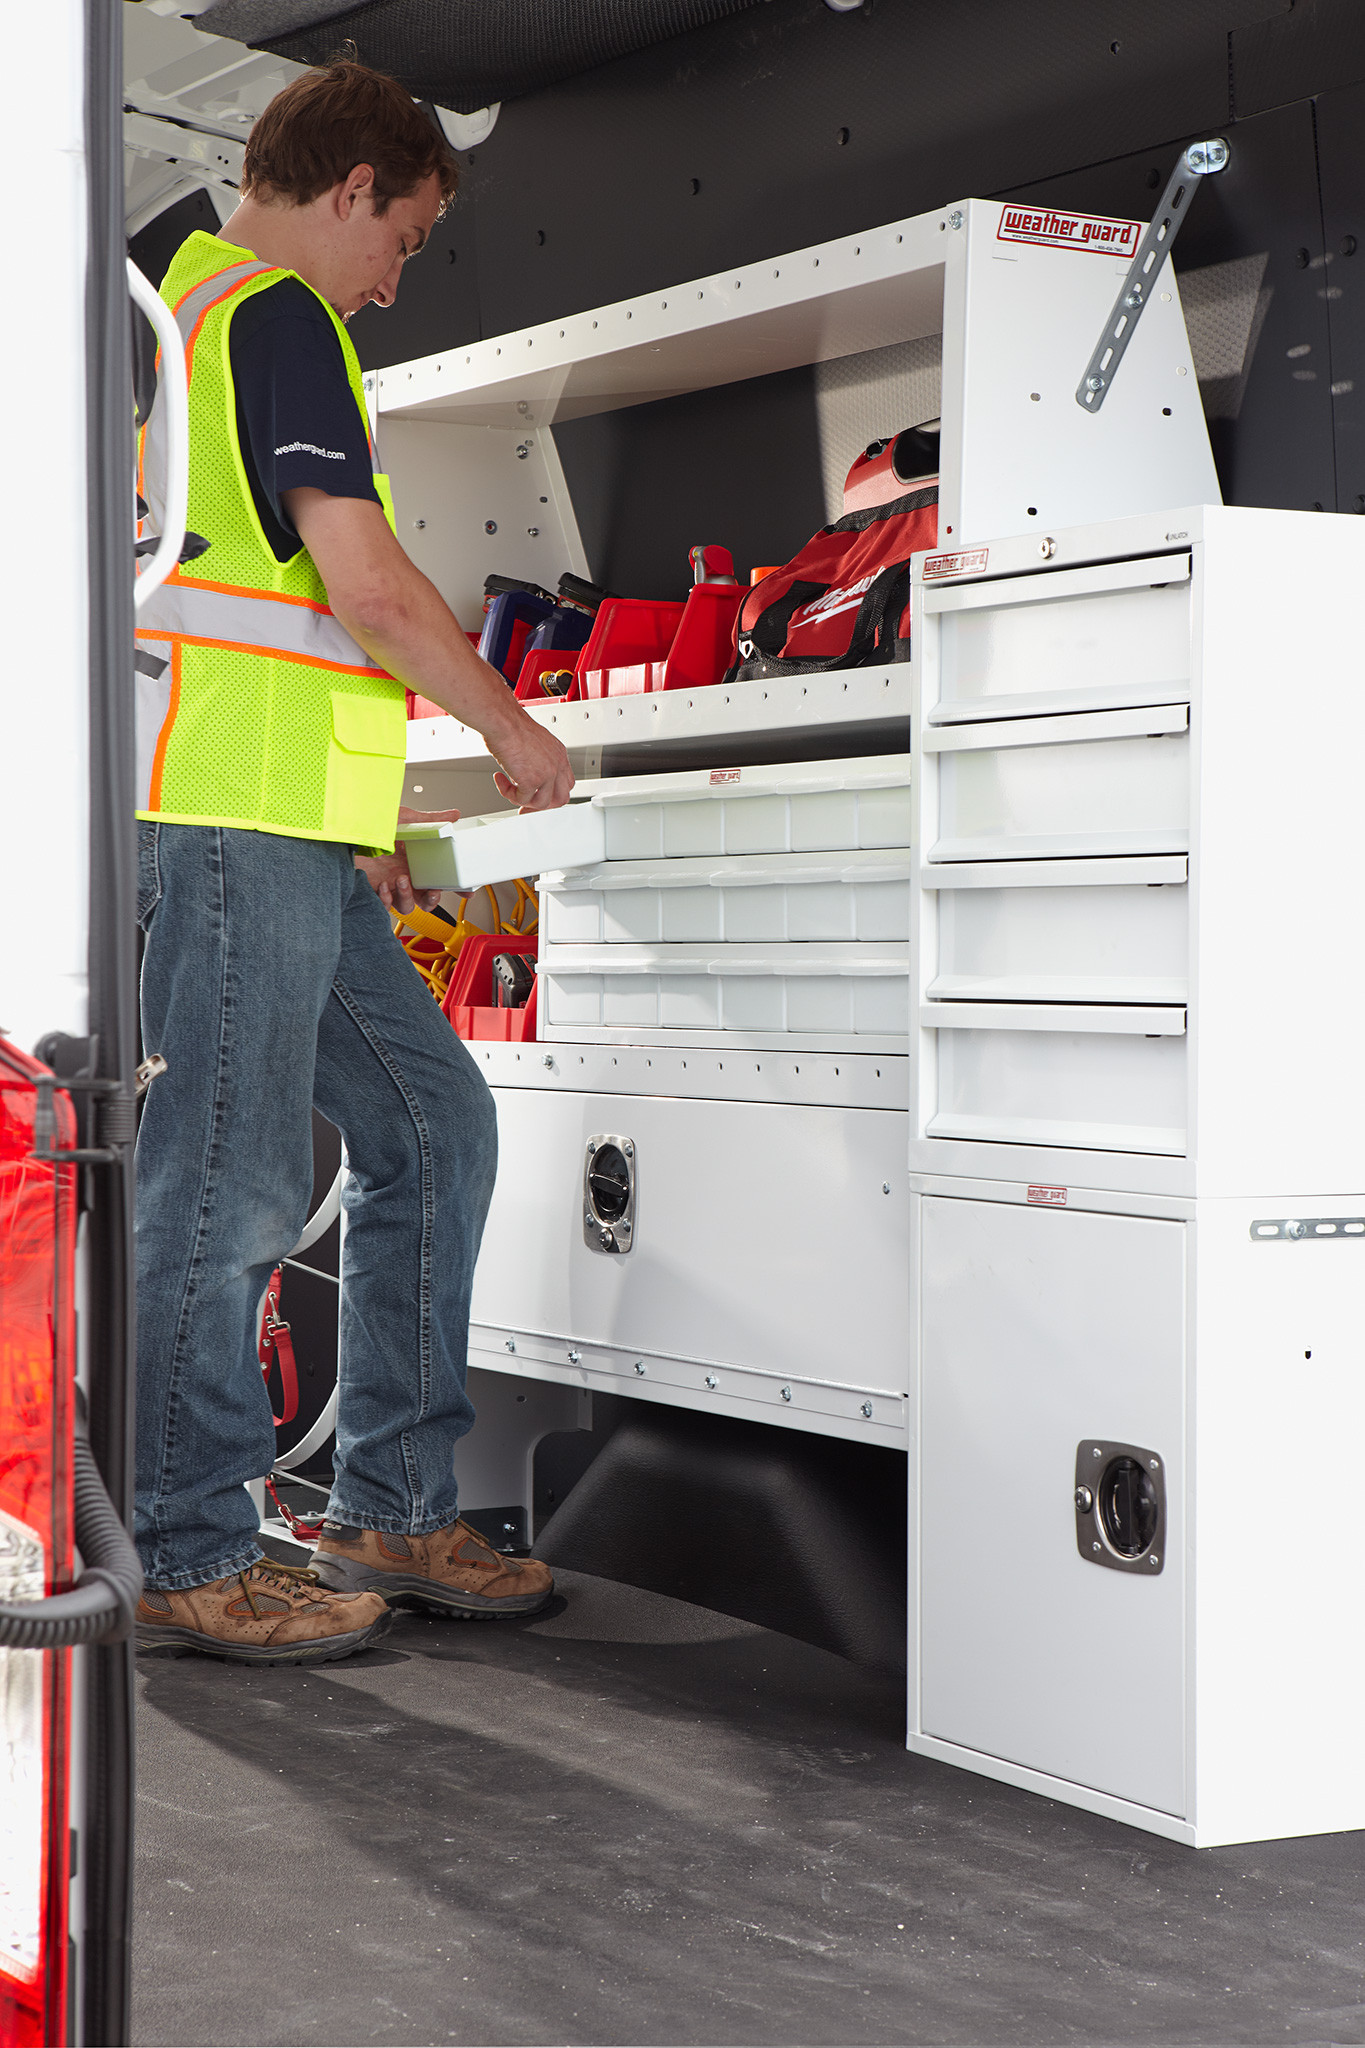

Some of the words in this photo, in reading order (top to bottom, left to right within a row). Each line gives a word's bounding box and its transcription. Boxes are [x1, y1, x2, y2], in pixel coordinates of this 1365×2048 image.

[1005, 212, 1078, 236] weather
[1082, 223, 1132, 243] guard
[274, 441, 346, 460] weathergd.com
[925, 556, 958, 571] weather
[961, 550, 985, 569] guard
